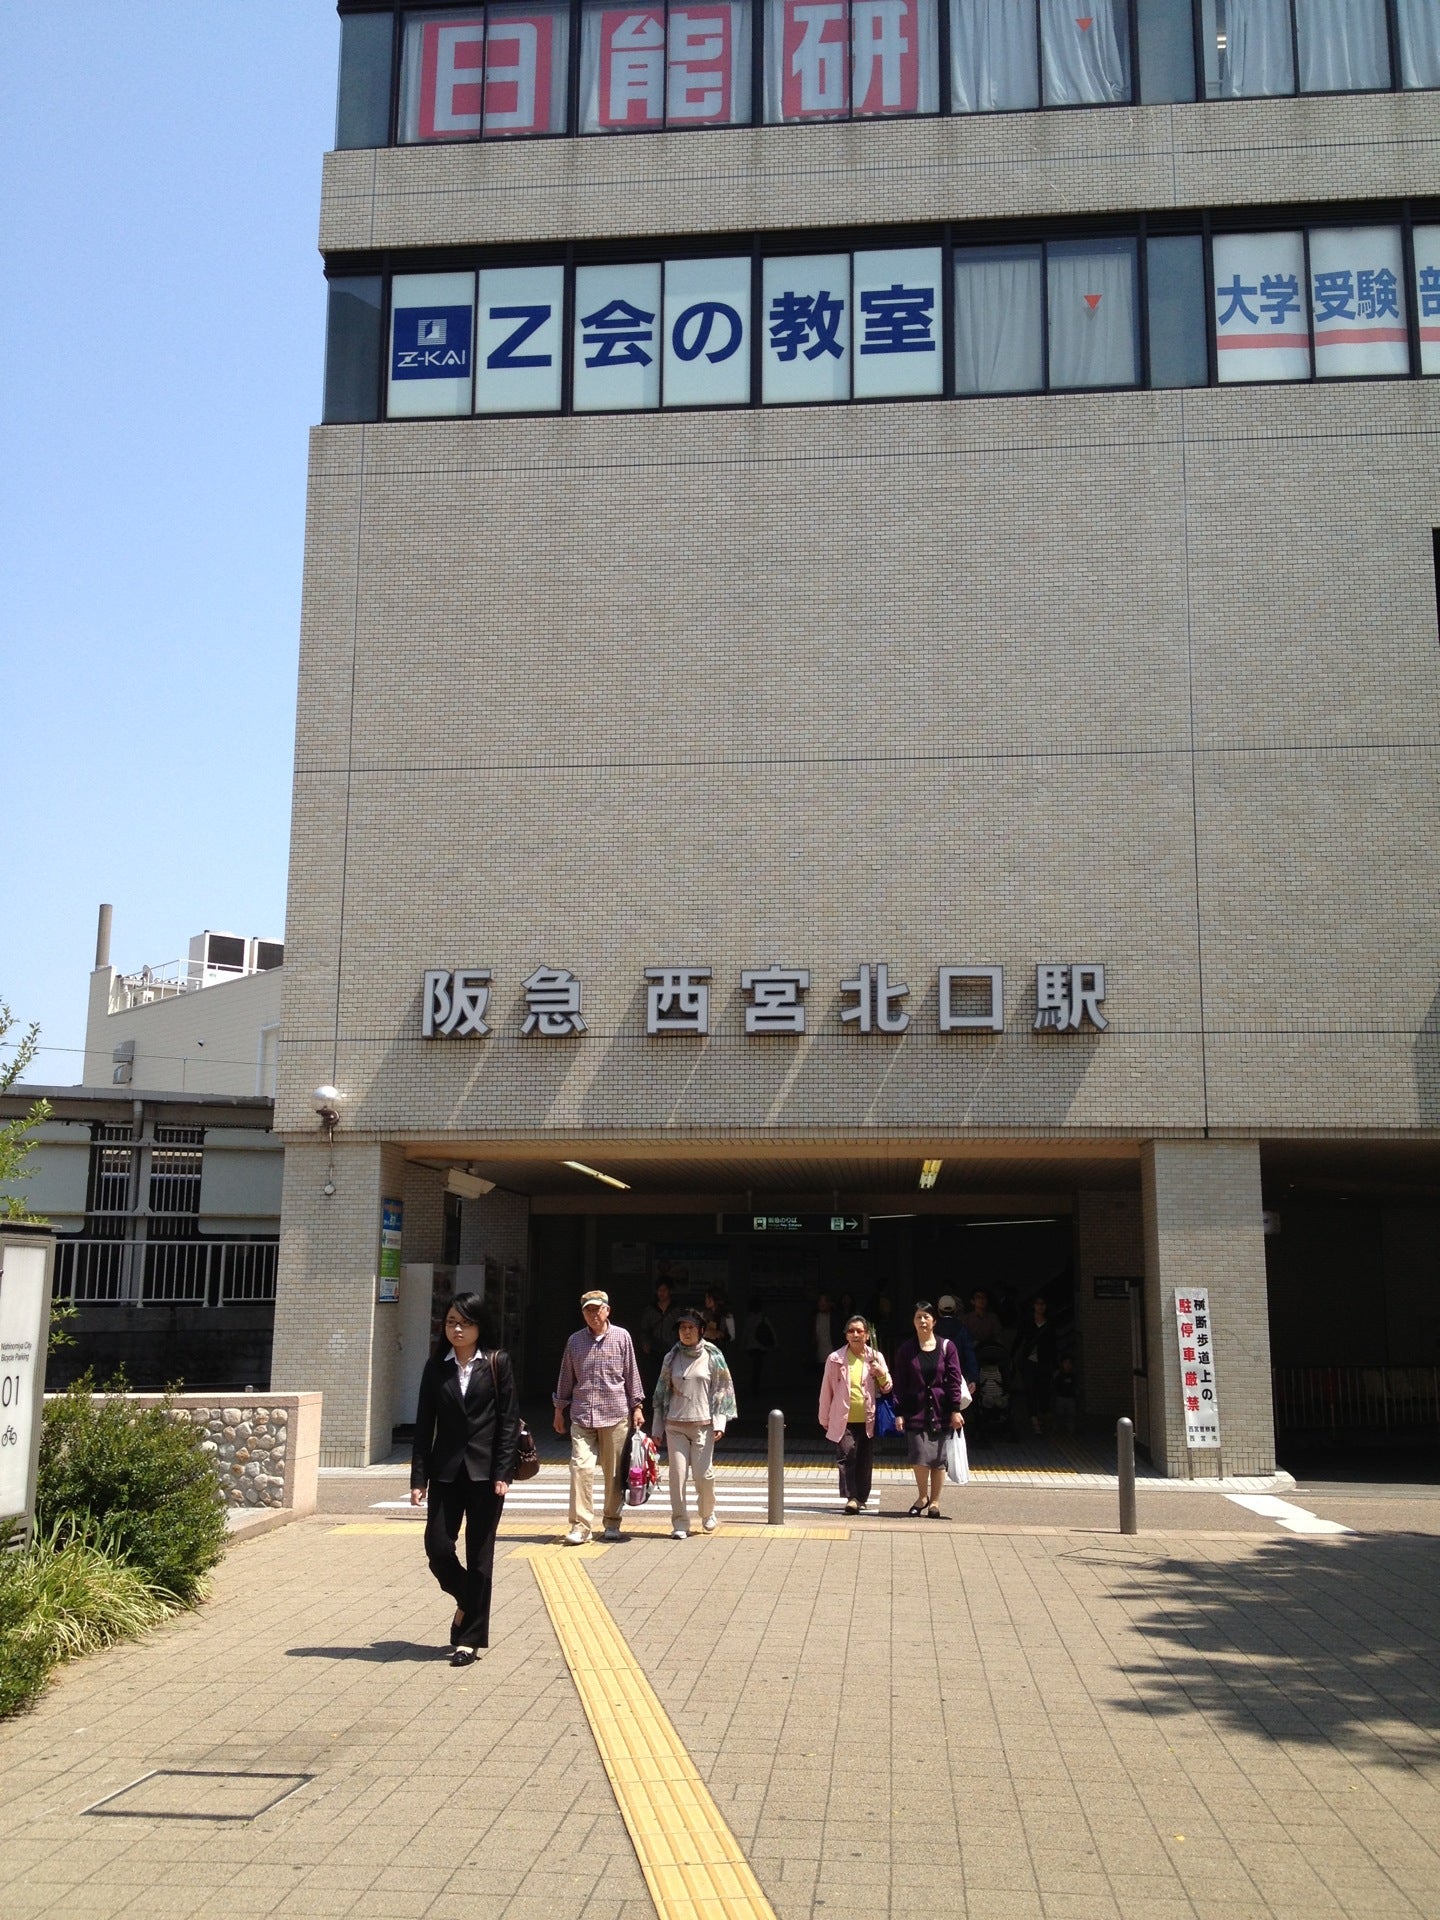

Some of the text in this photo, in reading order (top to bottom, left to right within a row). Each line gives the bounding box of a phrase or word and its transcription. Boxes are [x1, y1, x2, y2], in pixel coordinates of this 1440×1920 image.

[431, 0, 909, 132] 日能研
[398, 349, 466, 367] Z-KAI
[486, 284, 937, 370] Z会の教室
[2, 1375, 19, 1407] 01
[1178, 1298, 1200, 1412] 駐停車厳禁
